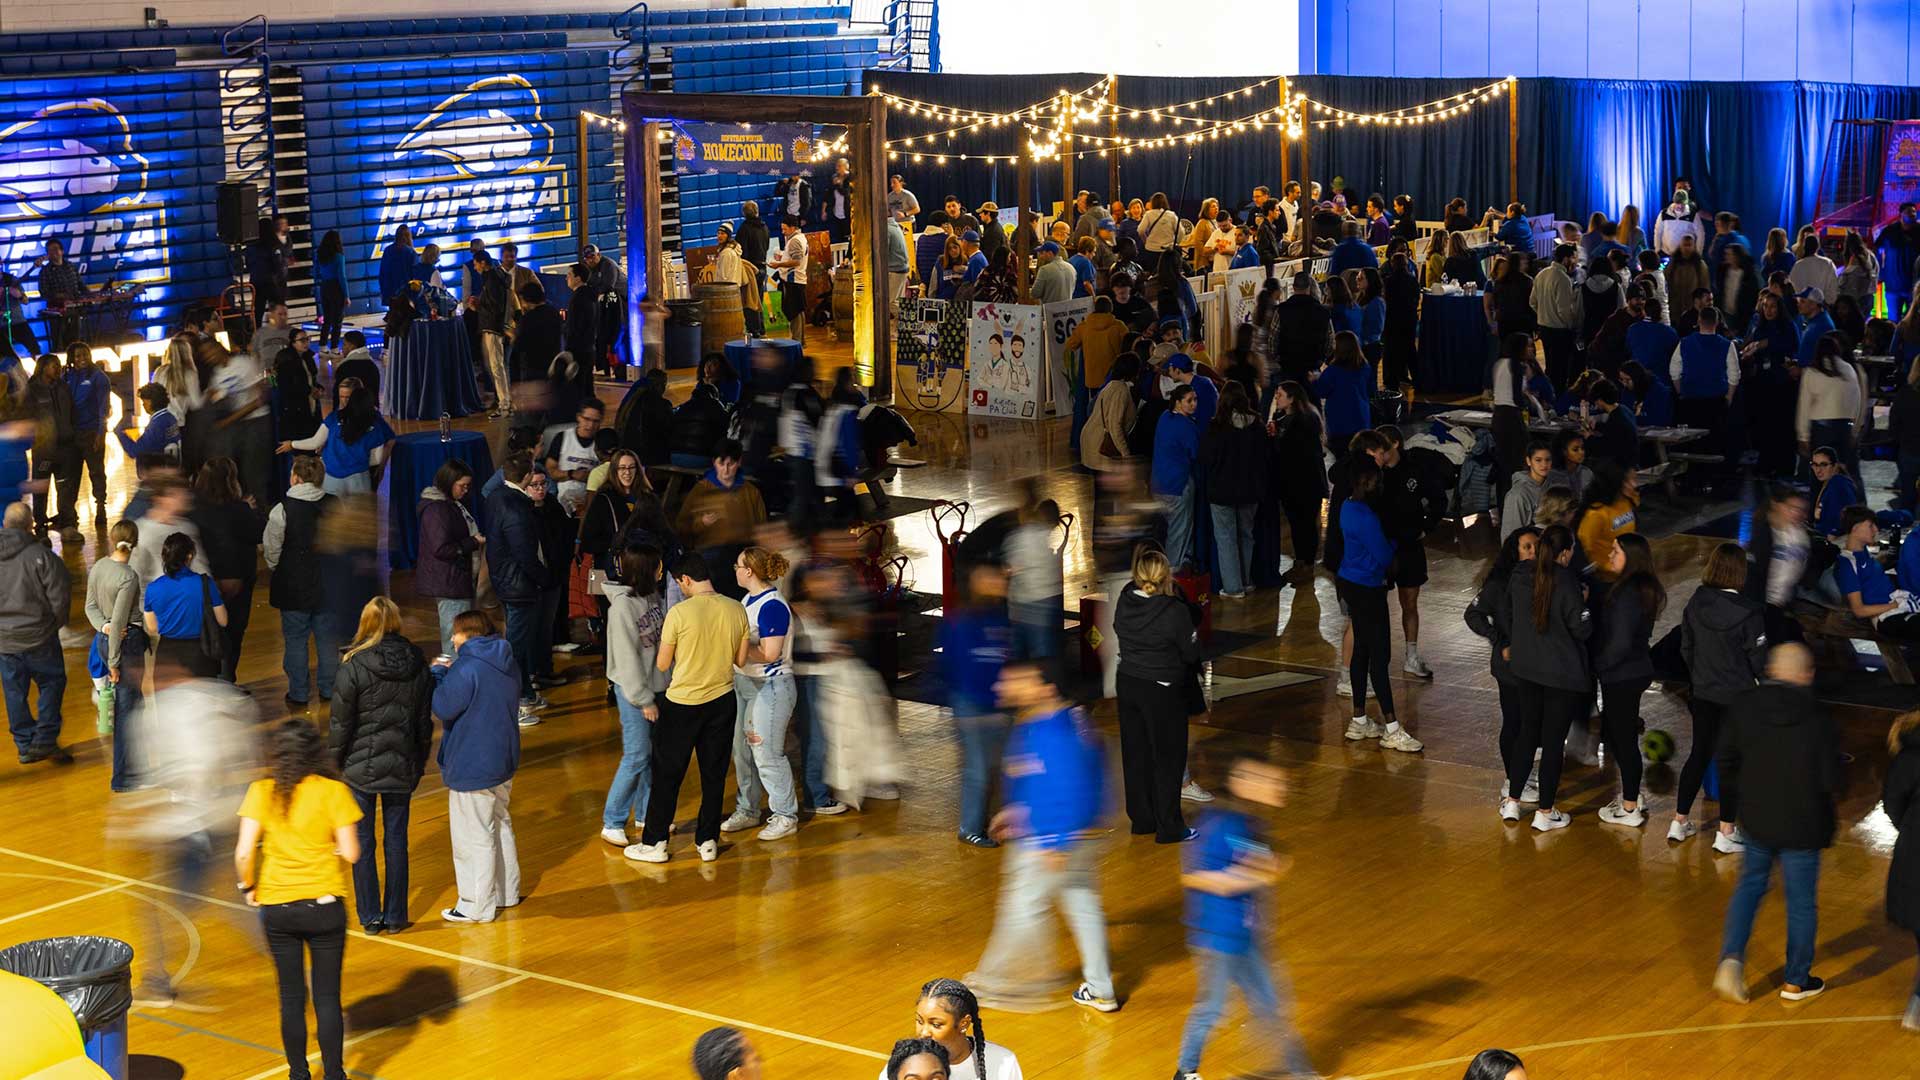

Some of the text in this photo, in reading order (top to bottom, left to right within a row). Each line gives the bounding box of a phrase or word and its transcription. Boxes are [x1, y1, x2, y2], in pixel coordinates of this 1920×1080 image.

[702, 143, 784, 162] HOMECOMING
[388, 175, 560, 231] HOFSTRA
[989, 404, 1000, 414] PA
